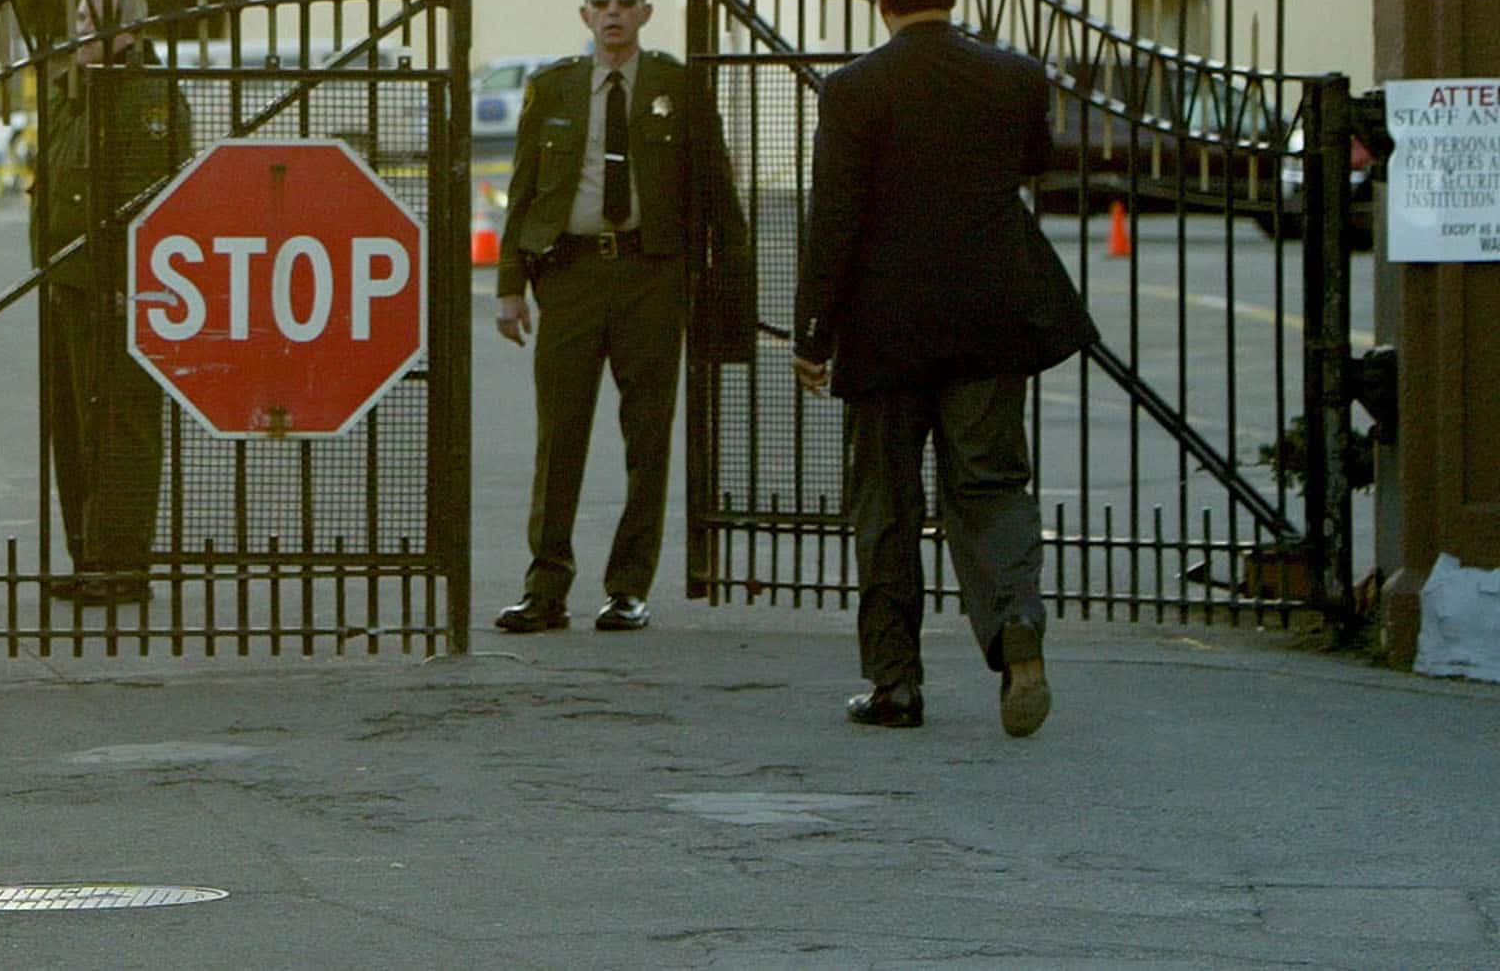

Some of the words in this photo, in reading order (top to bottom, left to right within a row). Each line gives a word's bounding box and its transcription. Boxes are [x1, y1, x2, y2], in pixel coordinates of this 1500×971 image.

[1394, 108, 1459, 126] STAFF
[1408, 136, 1428, 153] NO
[1406, 173, 1435, 191] THE
[1405, 191, 1494, 208] INSTITUTION
[147, 235, 410, 342] STOP
